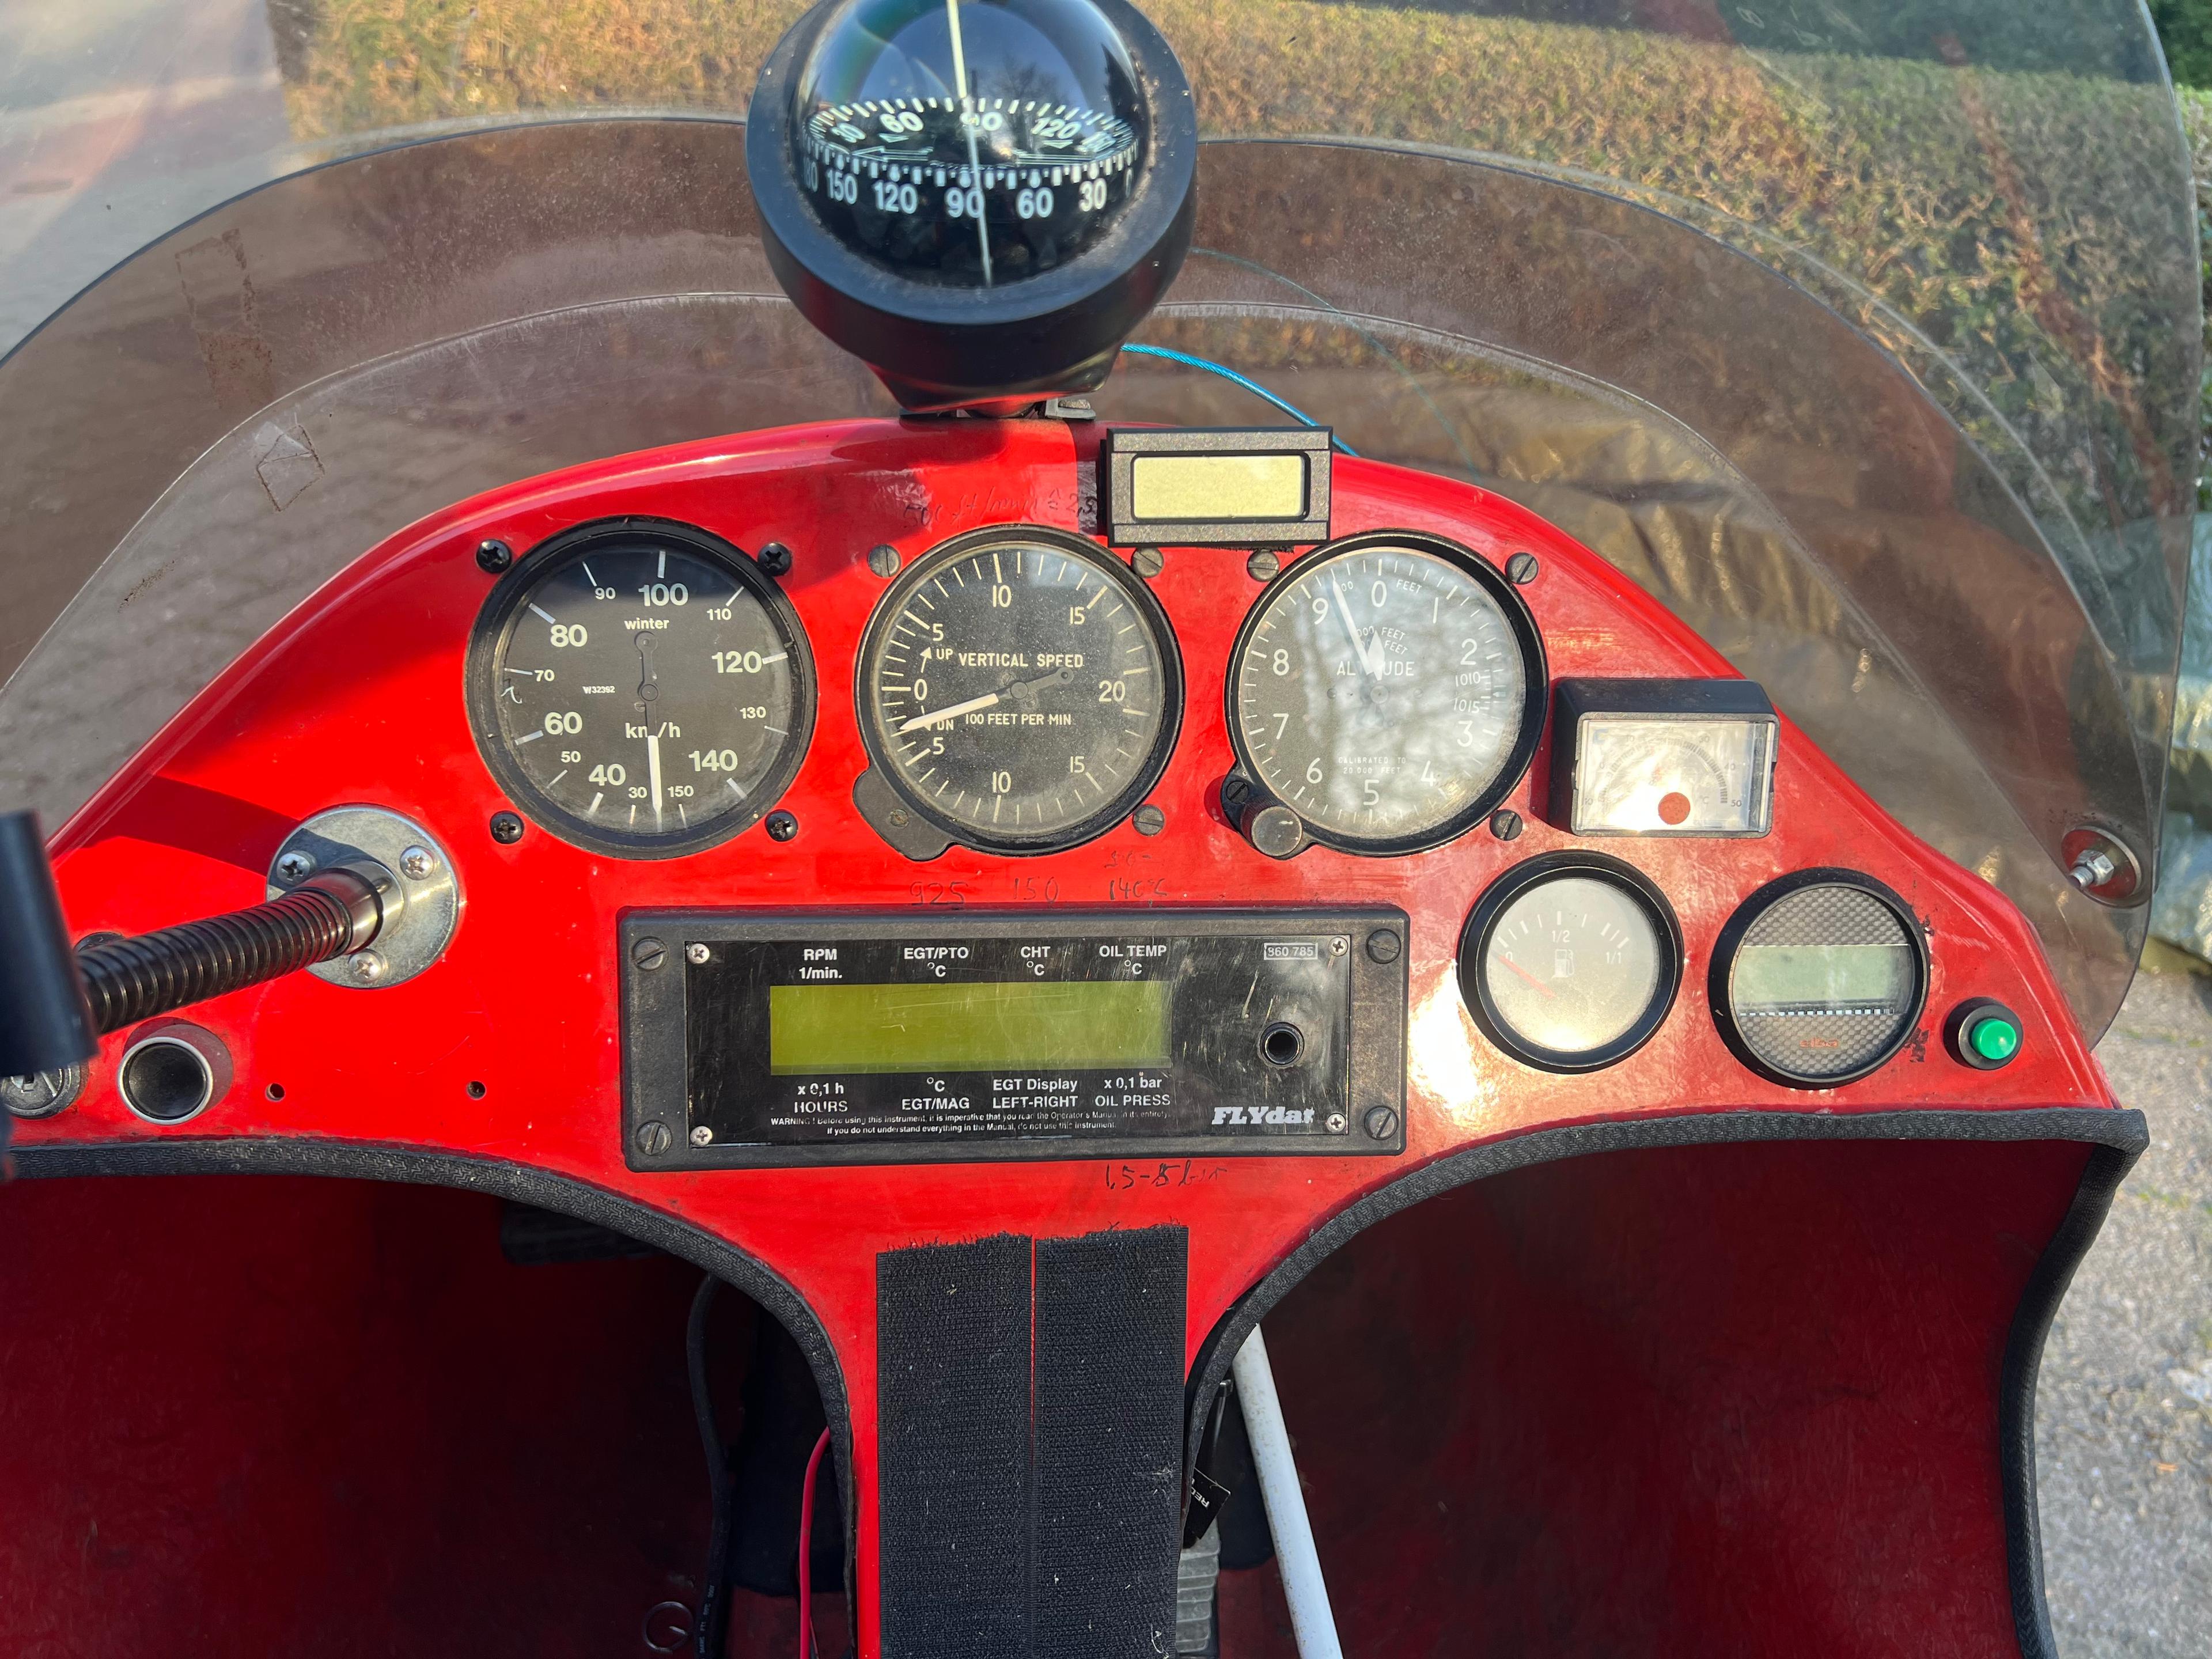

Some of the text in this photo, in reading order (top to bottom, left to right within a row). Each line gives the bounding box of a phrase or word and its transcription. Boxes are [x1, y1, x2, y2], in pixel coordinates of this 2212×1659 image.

[880, 111, 924, 133] 60
[1031, 116, 1082, 139] 120
[831, 122, 866, 143] 30
[826, 168, 858, 205] 150
[873, 181, 918, 215] 120
[1078, 178, 1108, 212] 30
[945, 187, 986, 219] 90
[1017, 187, 1054, 219] 60
[595, 588, 616, 600] 90
[1371, 580, 1387, 608] 0
[1396, 579, 1422, 594] FEET
[638, 584, 688, 607] 100
[992, 585, 1012, 607] 10
[707, 608, 732, 620] 110
[1070, 607, 1085, 624] 15
[1312, 597, 1329, 624] 9
[1433, 597, 1439, 624] 1
[624, 618, 669, 630] winter
[550, 625, 588, 647] 80
[933, 623, 945, 641] 5
[1381, 627, 1406, 641] FEET
[935, 648, 953, 660] UP
[1384, 640, 1408, 655] FEET
[1460, 638, 1477, 666] 2
[711, 652, 762, 673] 120
[959, 653, 1084, 668] VERTICAL SPEED
[1272, 649, 1290, 676] 8
[535, 670, 555, 681] 70
[1336, 661, 1415, 676] ALUDE
[1455, 672, 1480, 687] 1010
[914, 679, 927, 700] 0
[1098, 681, 1126, 702] 20
[740, 707, 766, 719] 130
[1453, 699, 1480, 714] 1015
[544, 712, 582, 734] 60
[937, 718, 954, 730] DN
[965, 713, 1071, 725] 100 FEET PER MIN
[1273, 713, 1289, 740] 7
[1457, 720, 1473, 747] 3
[933, 738, 945, 755] 5
[560, 751, 581, 763] 50
[688, 749, 738, 772] 140
[1070, 756, 1085, 774] 15
[1306, 757, 1323, 784] 6
[588, 764, 626, 786] 40
[1421, 760, 1437, 787] 4
[992, 772, 1012, 794] 10
[628, 787, 647, 798] 30
[667, 786, 694, 797] 150
[1363, 779, 1379, 805] 5
[1731, 799, 1743, 808] 50
[1013, 876, 1059, 902] 150
[1551, 930, 1571, 944] 1/2
[804, 949, 837, 961] RPM
[904, 946, 969, 960] EGT/PTO
[1020, 946, 1050, 958] CHT
[1099, 945, 1167, 957] OIL TEMP
[1292, 946, 1313, 956] 785
[1606, 952, 1622, 964] 1/1
[799, 966, 842, 979] 1/min.
[836, 1082, 844, 1094] h
[993, 1078, 1078, 1093] EGT Display
[1116, 1077, 1134, 1090] 0,1
[1140, 1077, 1162, 1088] bar
[794, 1100, 848, 1113] HOURS
[902, 1097, 969, 1111] EGT/MAG
[993, 1096, 1078, 1109] LEFT-RIGHT
[1095, 1094, 1171, 1107] OIL PRESS
[771, 1118, 810, 1126] WARNING
[868, 1115, 882, 1123] this
[945, 1113, 984, 1123] imperative
[986, 1113, 1001, 1121] that
[1002, 1113, 1017, 1122] you
[1037, 1112, 1048, 1120] the
[1211, 1106, 1315, 1125] FLYdat
[834, 1127, 849, 1136] you
[877, 1125, 921, 1133] understand
[922, 1124, 962, 1134] everything
